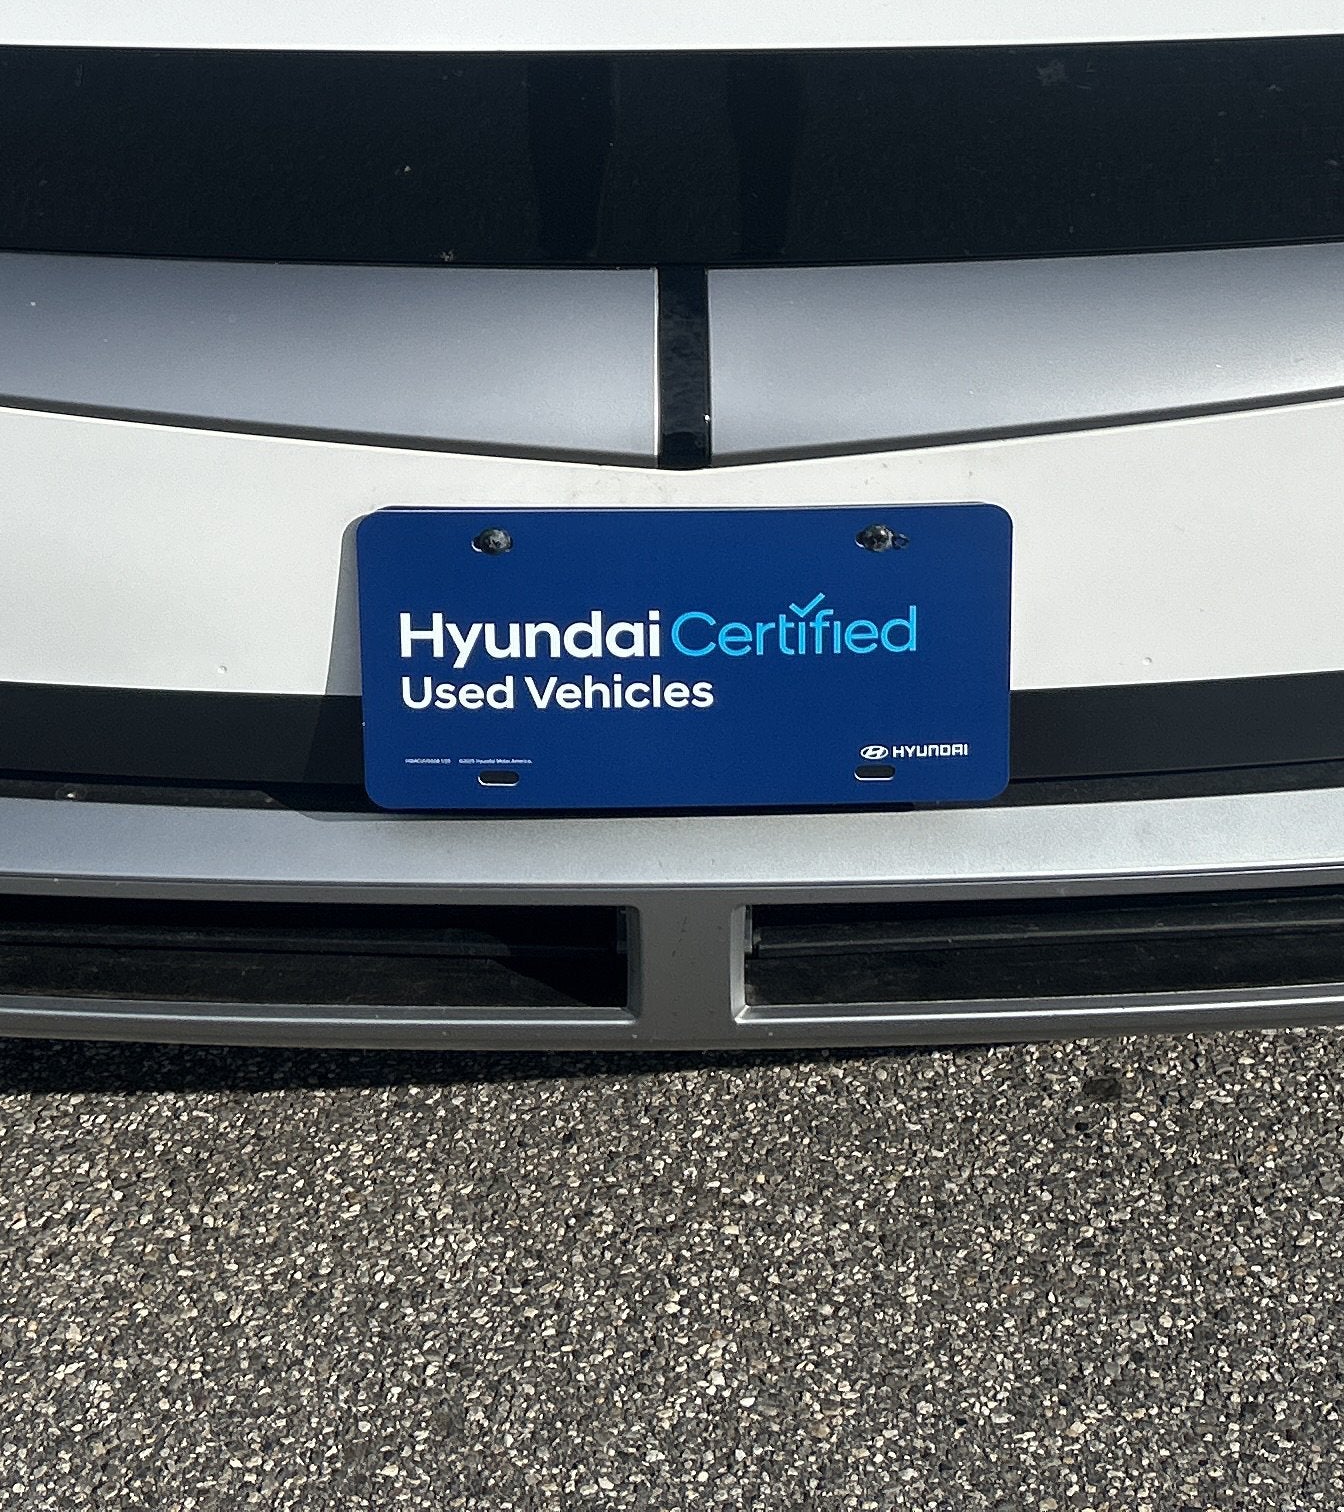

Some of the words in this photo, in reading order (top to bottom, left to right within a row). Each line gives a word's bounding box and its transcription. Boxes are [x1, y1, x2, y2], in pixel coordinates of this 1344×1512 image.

[399, 609, 661, 669] Hyundai
[671, 593, 917, 657] Certified
[401, 675, 515, 710] Used
[524, 673, 714, 710] Vehicles
[892, 743, 969, 758] HYUNDAI
